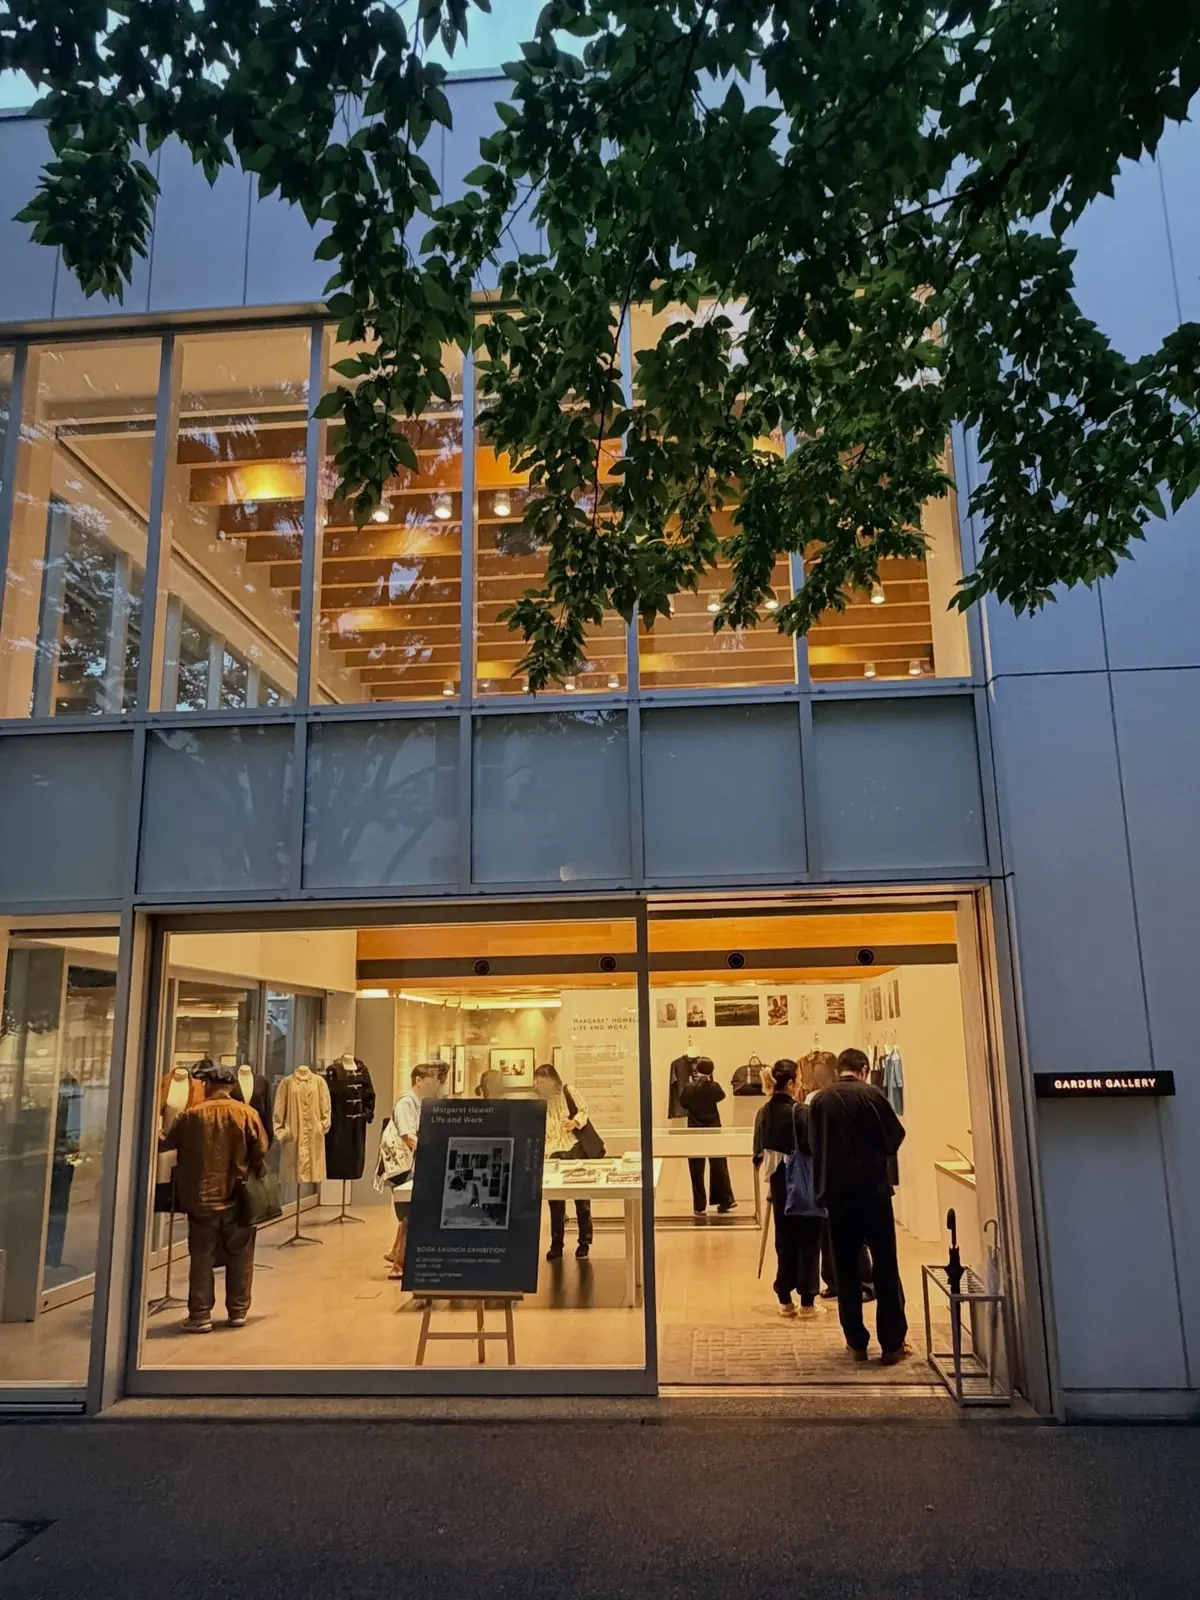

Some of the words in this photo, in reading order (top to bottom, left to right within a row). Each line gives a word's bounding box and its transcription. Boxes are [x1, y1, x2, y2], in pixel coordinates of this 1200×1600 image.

[1054, 1079, 1101, 1089] GARDEN
[1105, 1078, 1156, 1088] GALLERY
[432, 1106, 466, 1114] Margaret
[431, 1115, 446, 1123] Life
[447, 1115, 462, 1123] and
[463, 1115, 484, 1123] Work
